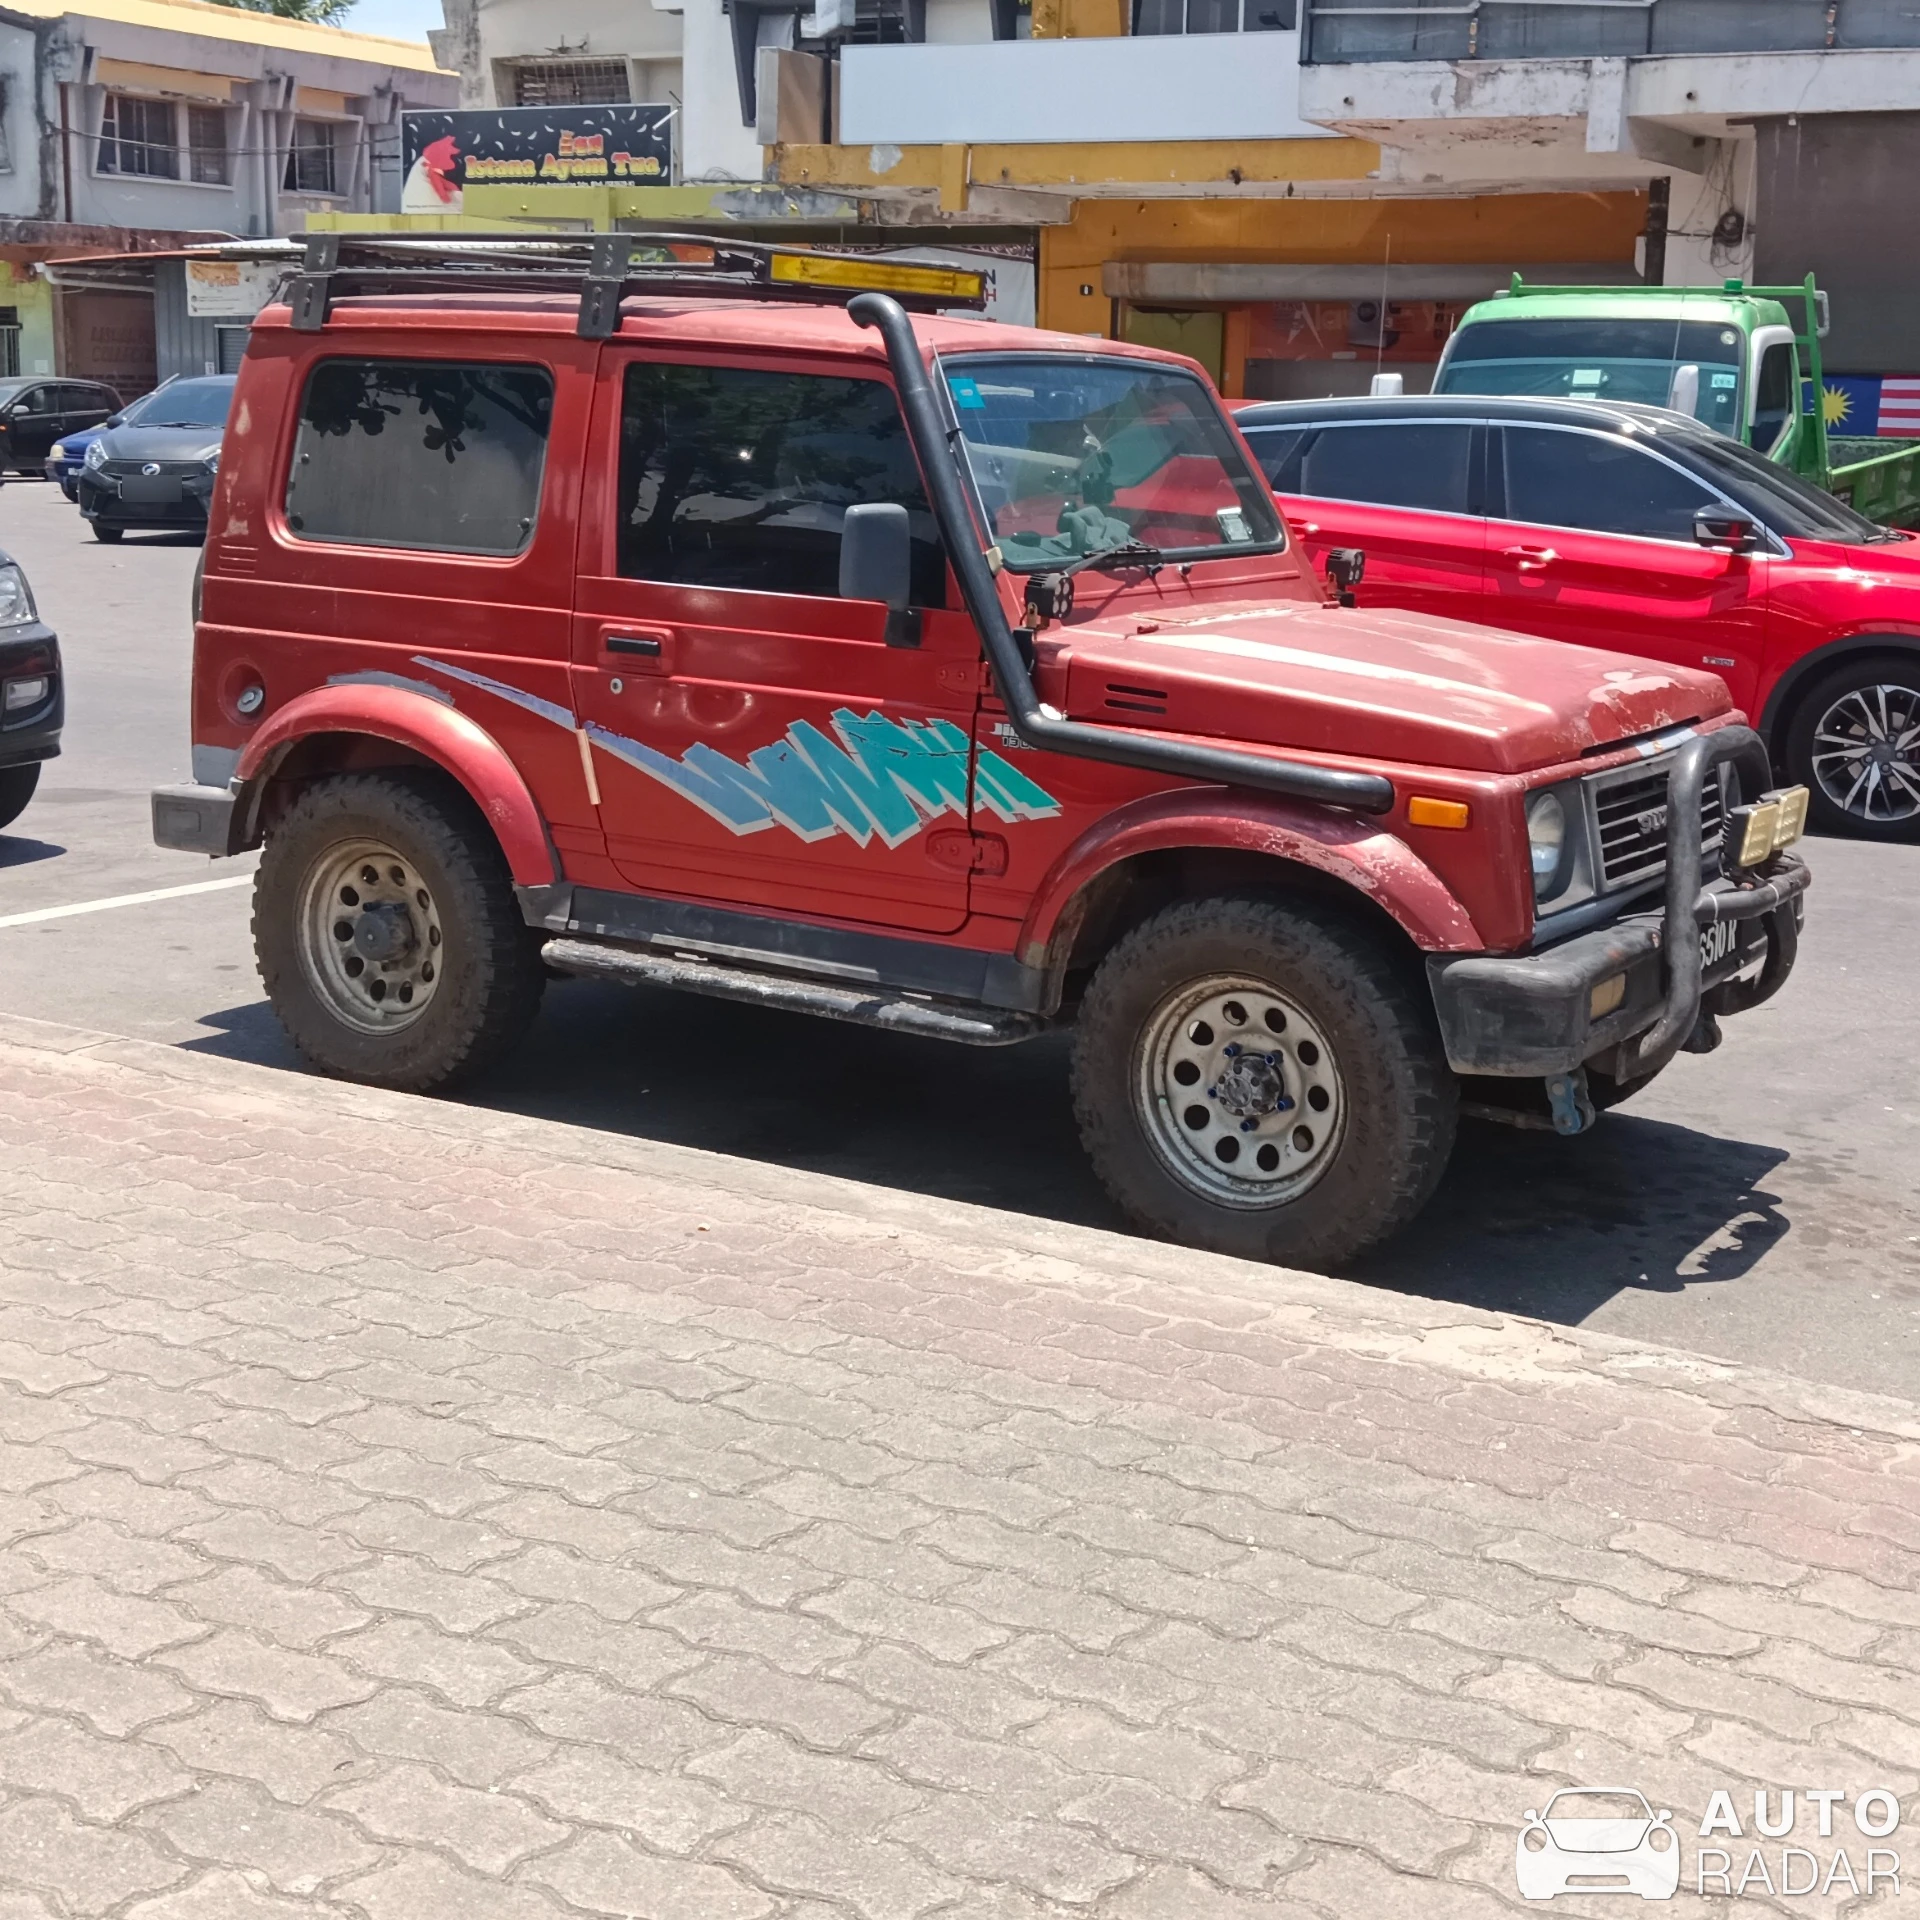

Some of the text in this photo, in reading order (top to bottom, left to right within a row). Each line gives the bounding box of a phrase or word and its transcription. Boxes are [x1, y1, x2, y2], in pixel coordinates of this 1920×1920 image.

[465, 152, 661, 181] Istana Ayam Tua
